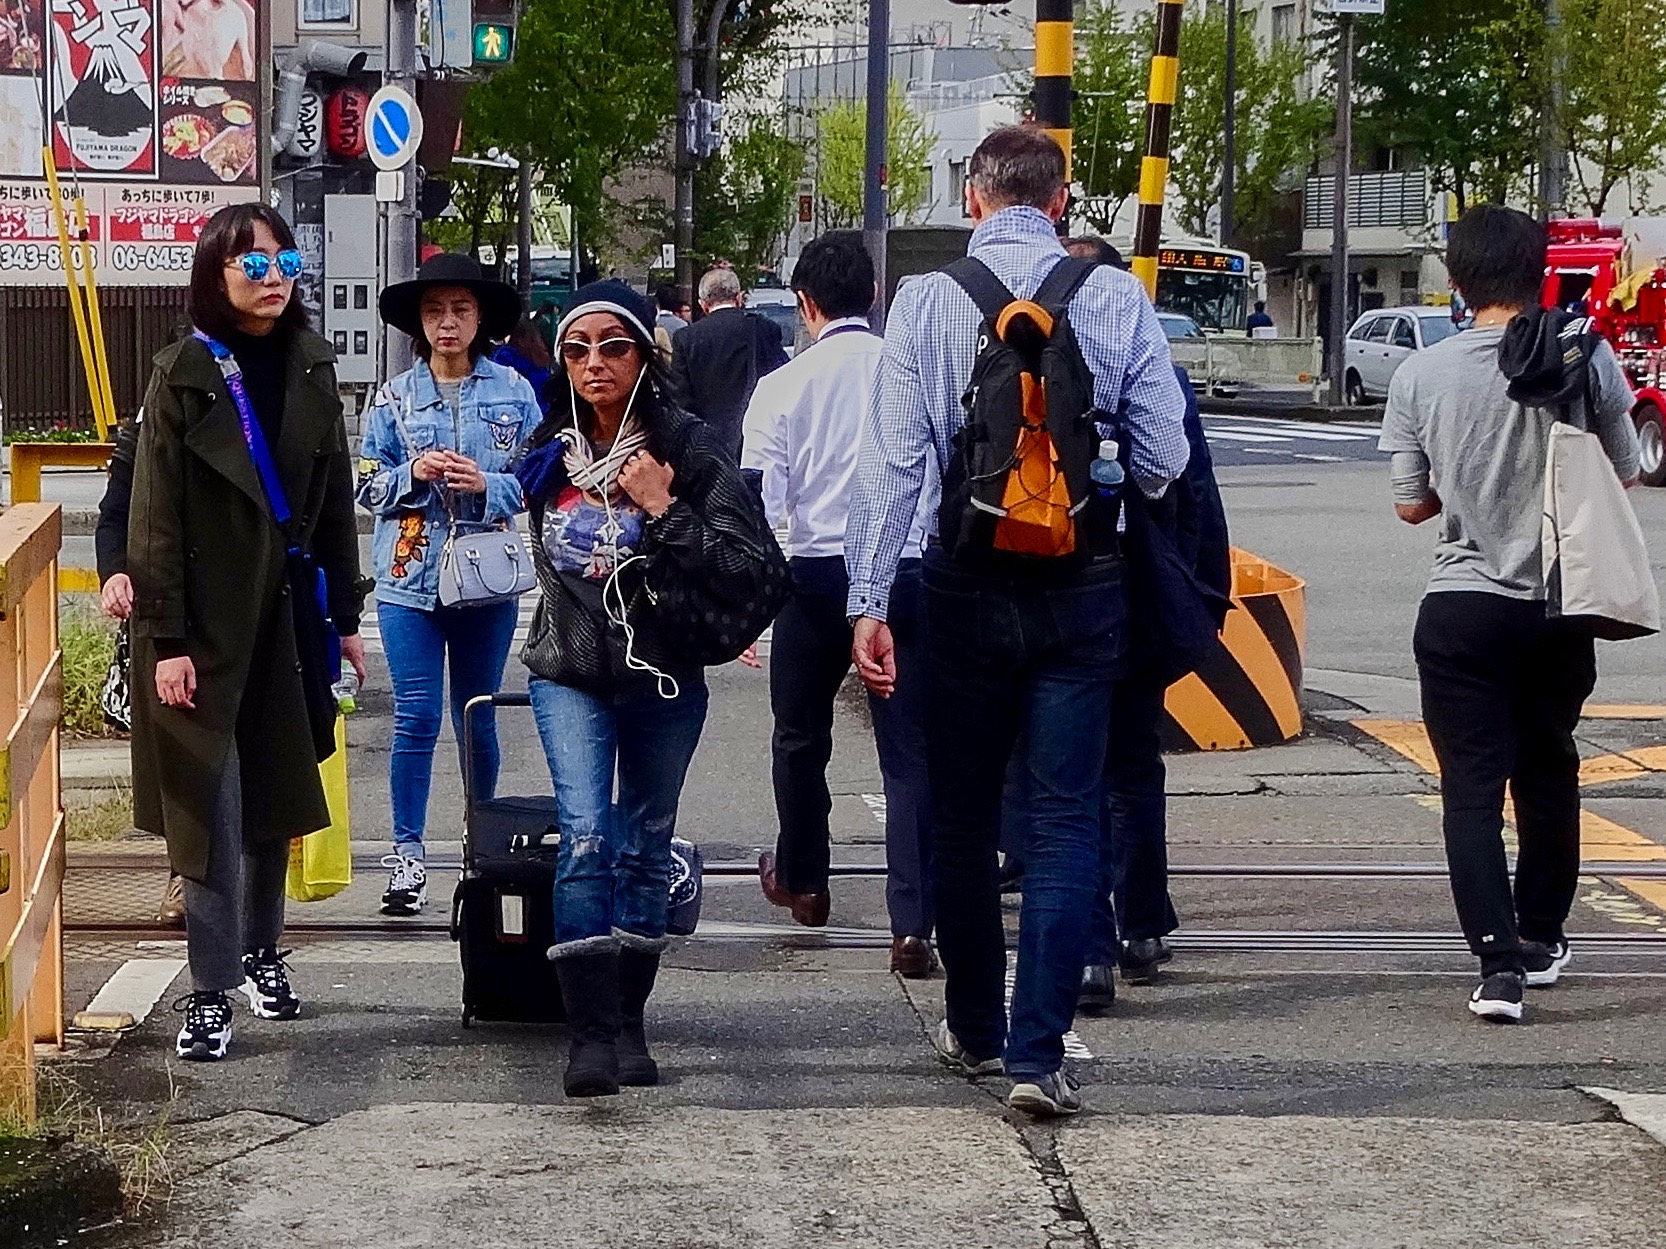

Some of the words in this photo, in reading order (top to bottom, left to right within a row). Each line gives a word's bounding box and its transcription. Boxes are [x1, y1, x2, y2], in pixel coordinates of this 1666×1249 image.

[121, 188, 215, 204] あっちに歩いて7歩!
[115, 207, 199, 224] フジヤマドラゴン
